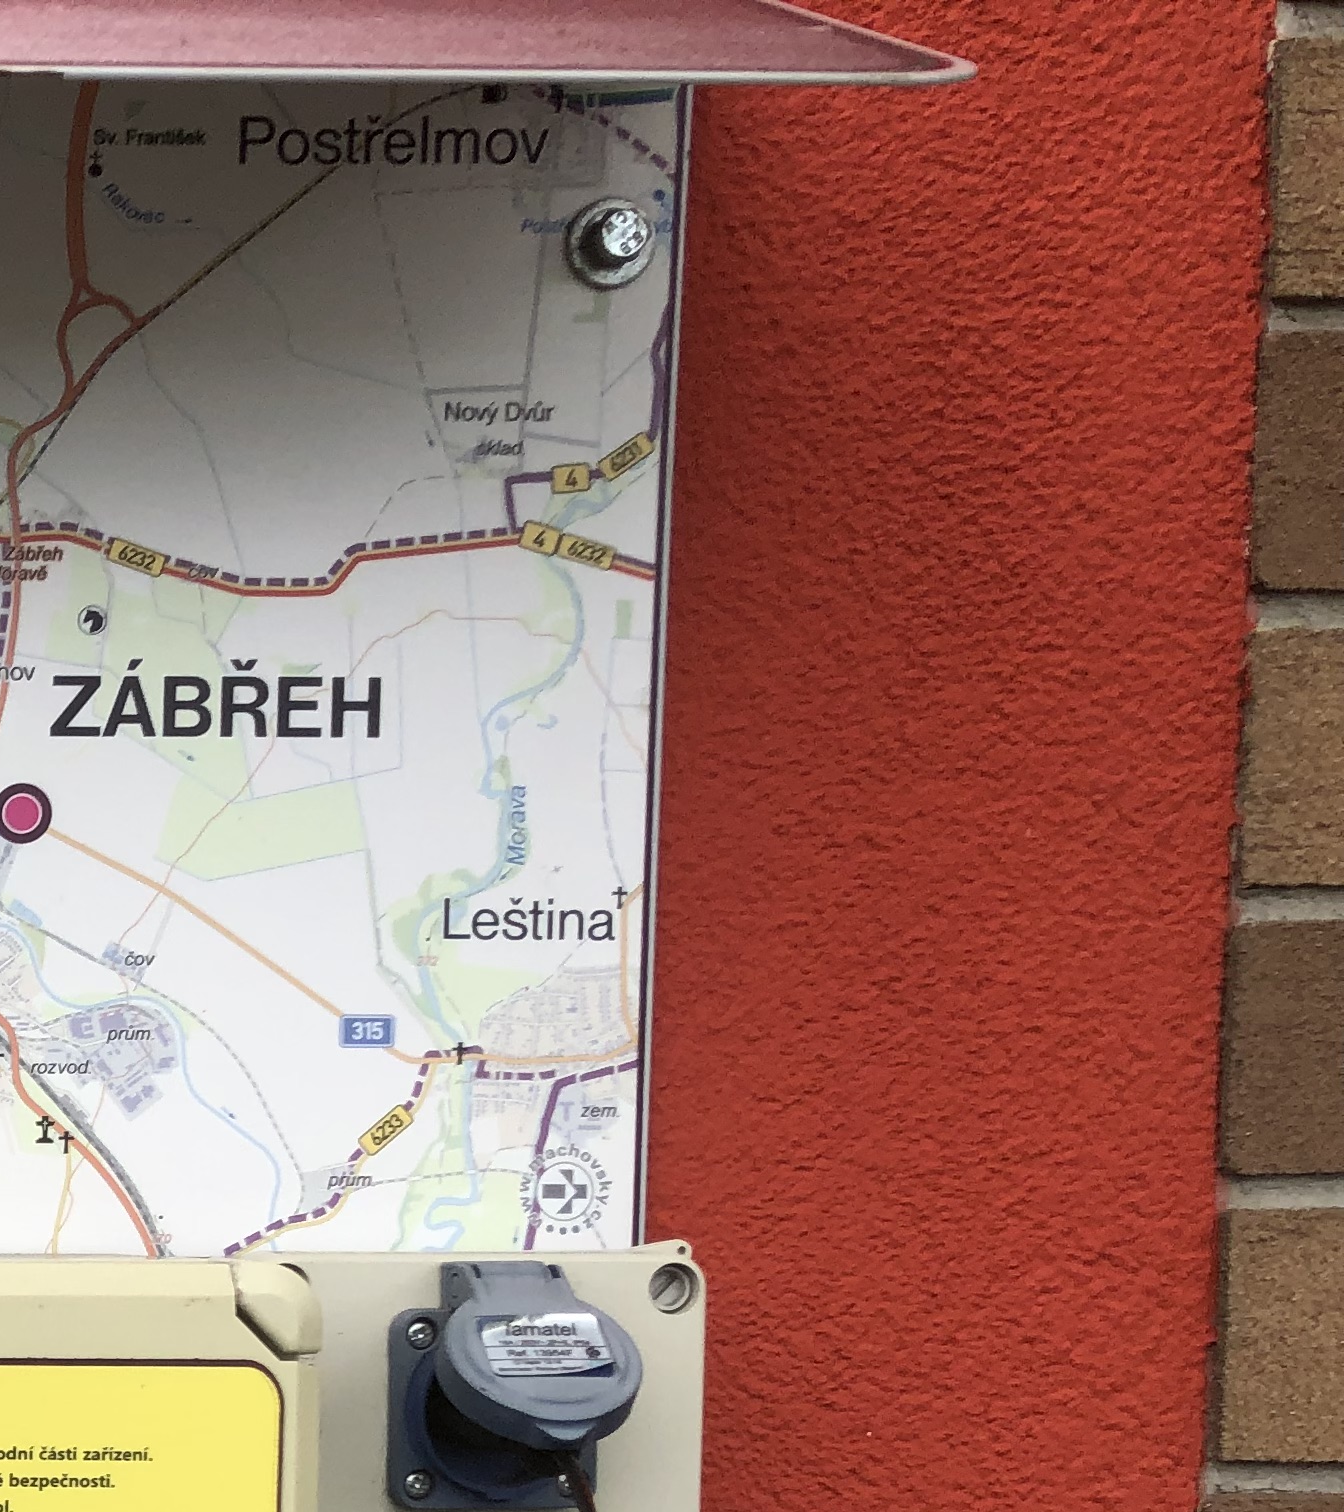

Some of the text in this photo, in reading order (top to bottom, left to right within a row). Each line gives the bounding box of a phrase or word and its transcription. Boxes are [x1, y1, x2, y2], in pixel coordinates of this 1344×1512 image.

[237, 114, 550, 168] Postřelmov
[49, 658, 382, 739] ZÁBŘEH
[442, 897, 616, 942] Leština
[30, 1059, 93, 1076] rozvod.
[38, 1446, 77, 1461] části
[82, 1446, 153, 1462] zařízení.
